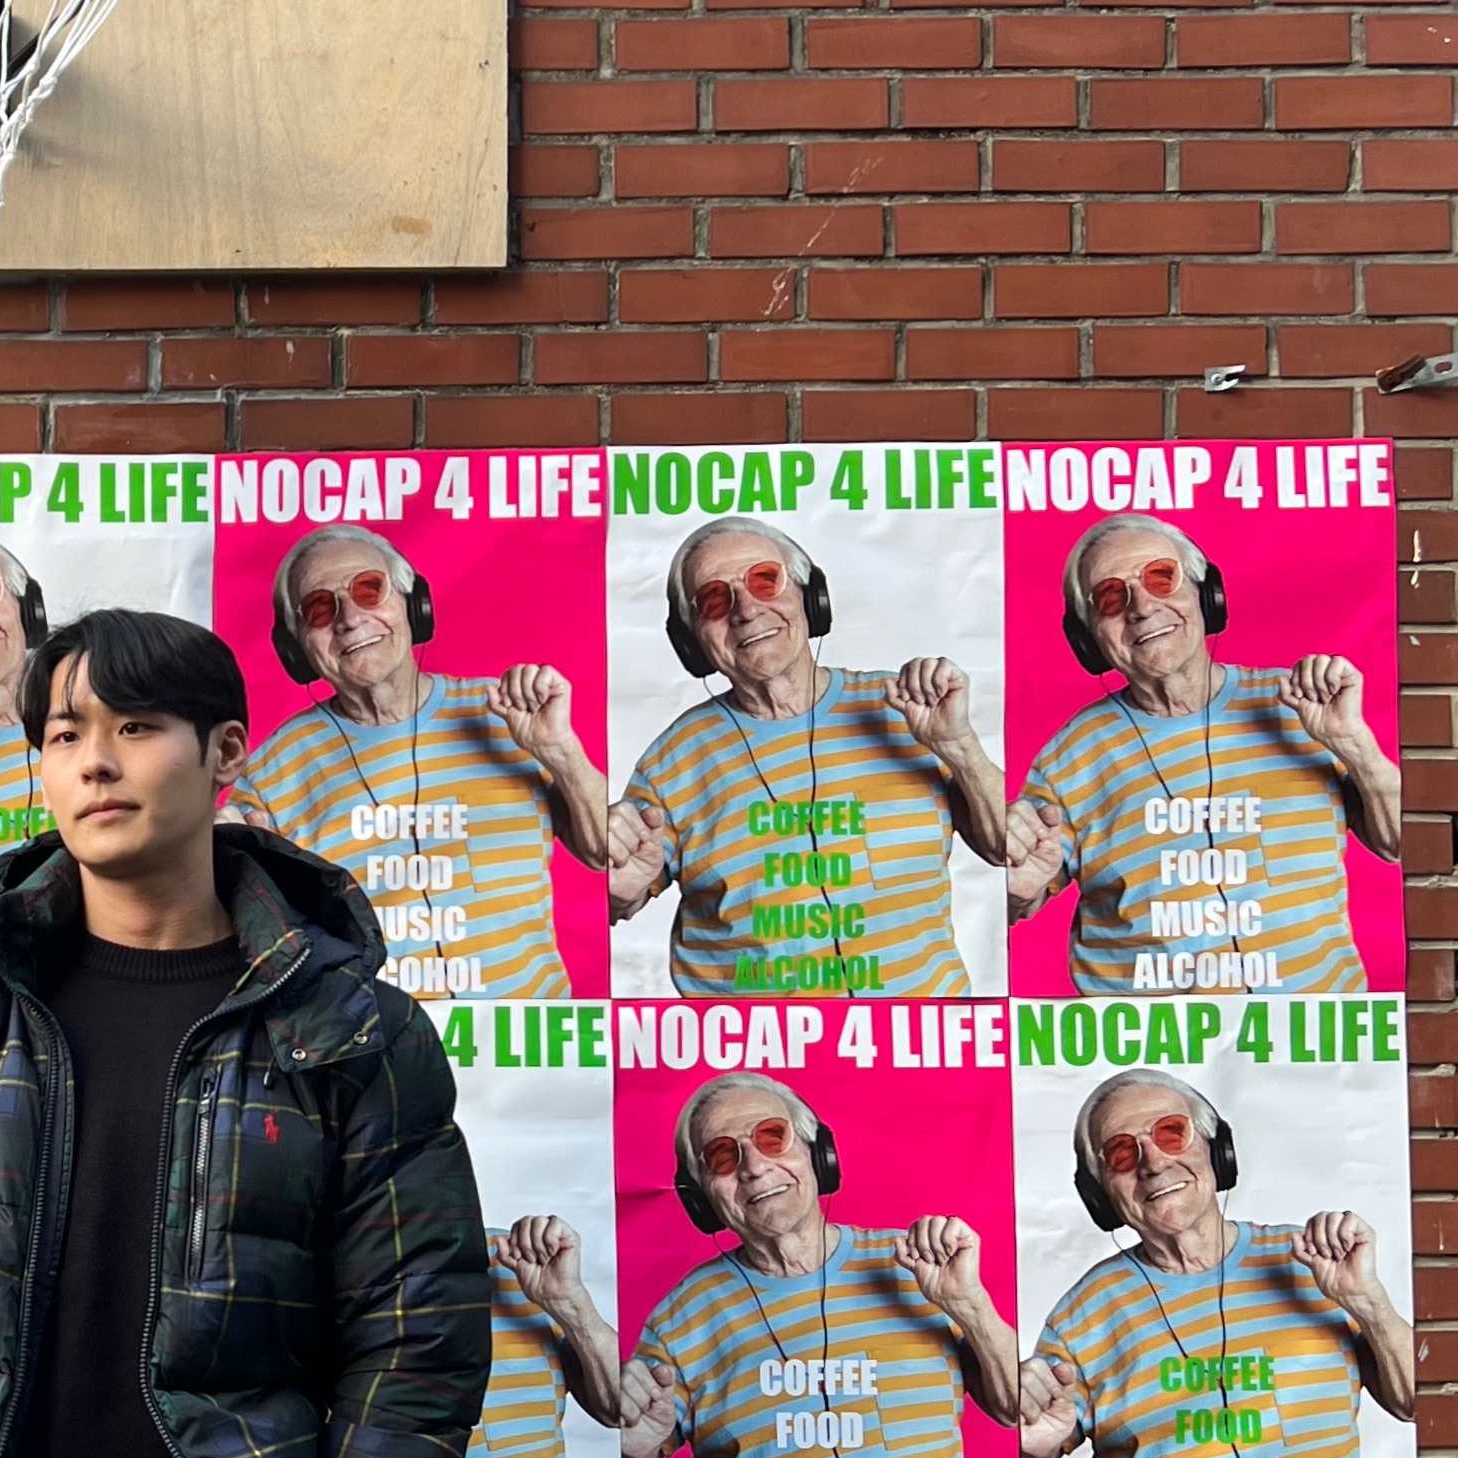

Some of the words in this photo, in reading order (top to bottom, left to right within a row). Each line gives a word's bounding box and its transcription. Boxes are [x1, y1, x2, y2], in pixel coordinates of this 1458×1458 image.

[46, 463, 84, 523] 4
[99, 462, 209, 523] LIFE
[221, 458, 420, 523] NOCAP
[435, 456, 473, 520] 4
[489, 454, 601, 519] LIFE
[613, 451, 814, 515] NOCAP
[830, 450, 868, 511] 4
[885, 448, 997, 510] LIFE
[1010, 447, 1211, 512] NOCAP
[1225, 446, 1263, 509] 4
[1278, 445, 1390, 509] LIFE
[351, 804, 468, 841] COFFEE
[748, 800, 865, 837] COFFEE
[1145, 797, 1261, 834] COFFEE
[367, 855, 453, 891] FOOD
[764, 851, 851, 888] FOOD
[1160, 848, 1246, 885] FOOD
[374, 906, 466, 942] USIC
[752, 903, 865, 940] MUSIC
[1150, 900, 1262, 937] MUSIC
[376, 956, 487, 993] COHOL
[734, 953, 884, 990] ALCOHOL
[1133, 951, 1282, 988] ALCOHOL
[444, 1006, 476, 1067] 4
[494, 1006, 605, 1067] LIFE
[620, 1007, 823, 1071] NOCAP
[838, 1006, 878, 1068] 4
[893, 1004, 1006, 1068] LIFE
[1019, 1004, 1221, 1066] NOCAP
[1235, 1003, 1274, 1063] 4
[1290, 1001, 1401, 1063] LIFE
[760, 1359, 878, 1396] COFFEE
[1159, 1355, 1275, 1392] COFFEE
[776, 1411, 863, 1449] FOOD
[1175, 1407, 1262, 1444] FOOD
